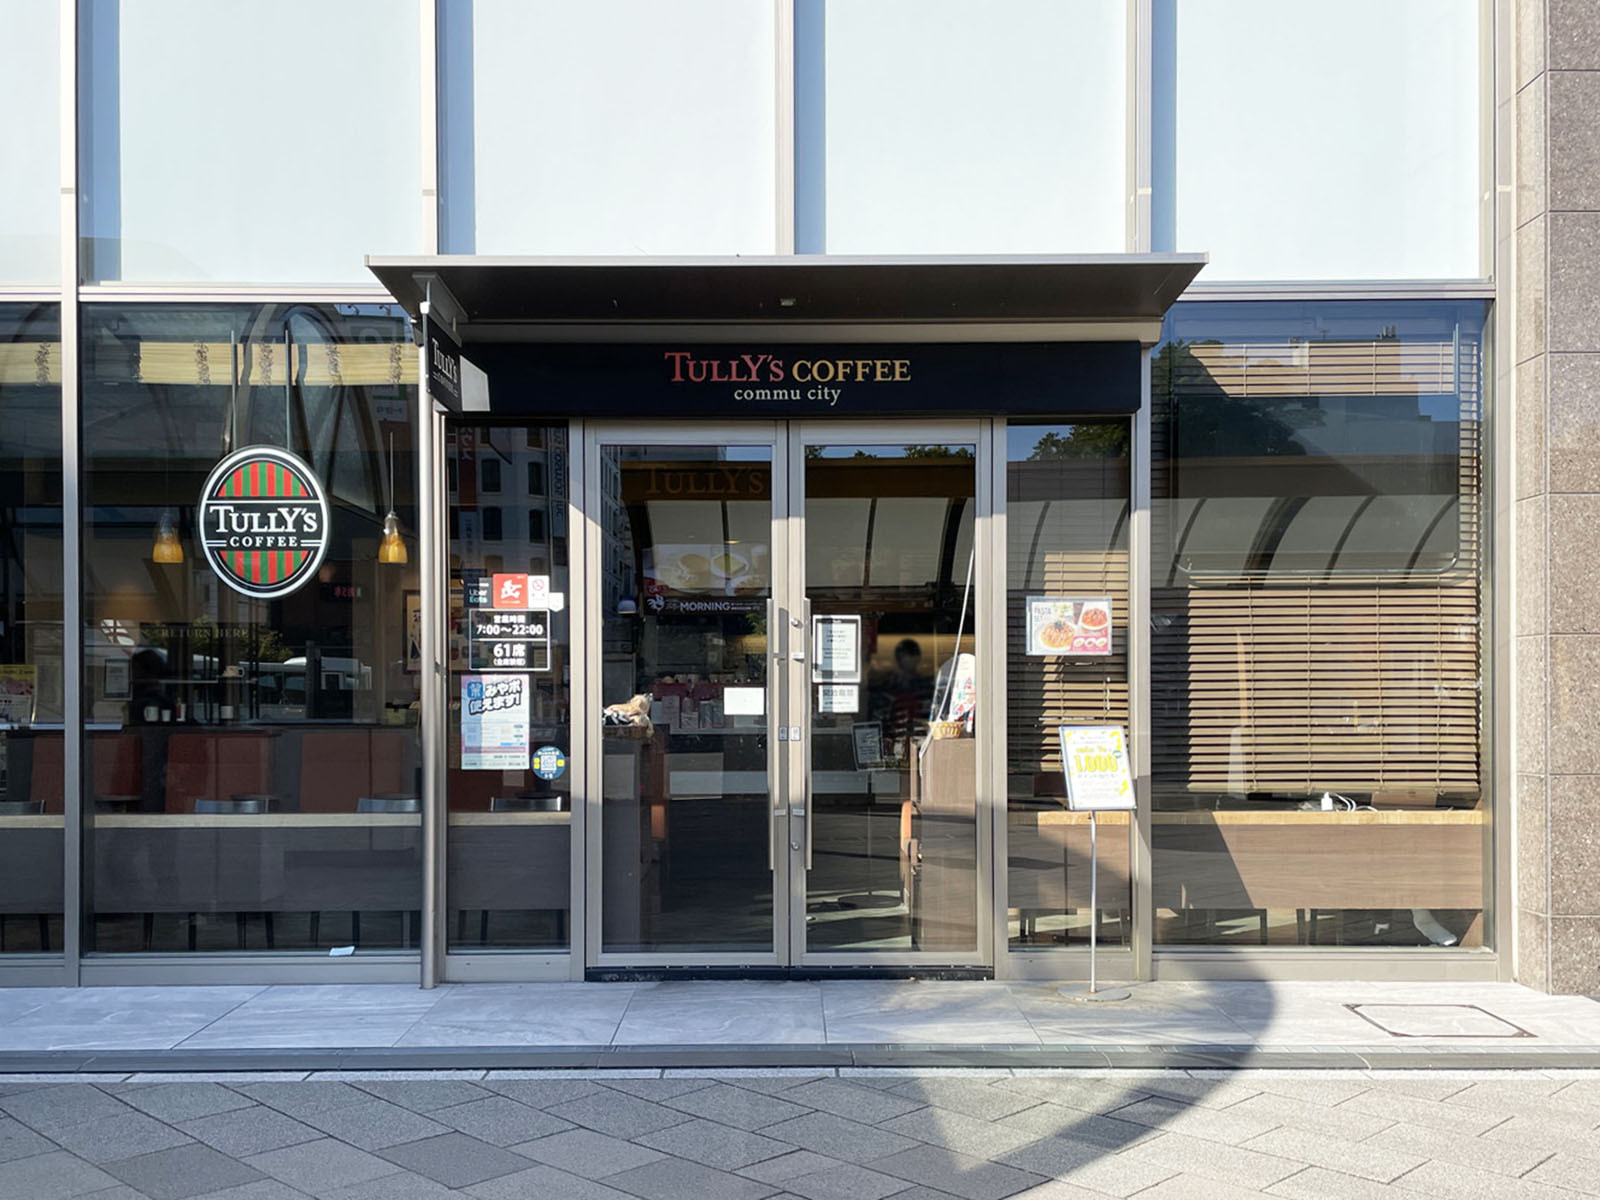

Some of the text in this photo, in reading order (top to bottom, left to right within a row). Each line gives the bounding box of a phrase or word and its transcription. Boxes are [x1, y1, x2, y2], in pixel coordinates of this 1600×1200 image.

[664, 352, 912, 383] TULLY'S COFFEE
[734, 385, 842, 406] commu city
[646, 465, 765, 495] TULLY'S
[209, 505, 318, 533] TULLY'S
[229, 536, 298, 547] COFFEE
[680, 601, 731, 611] MORNING
[161, 628, 250, 639] RETURN HERE
[493, 643, 526, 657] 61席
